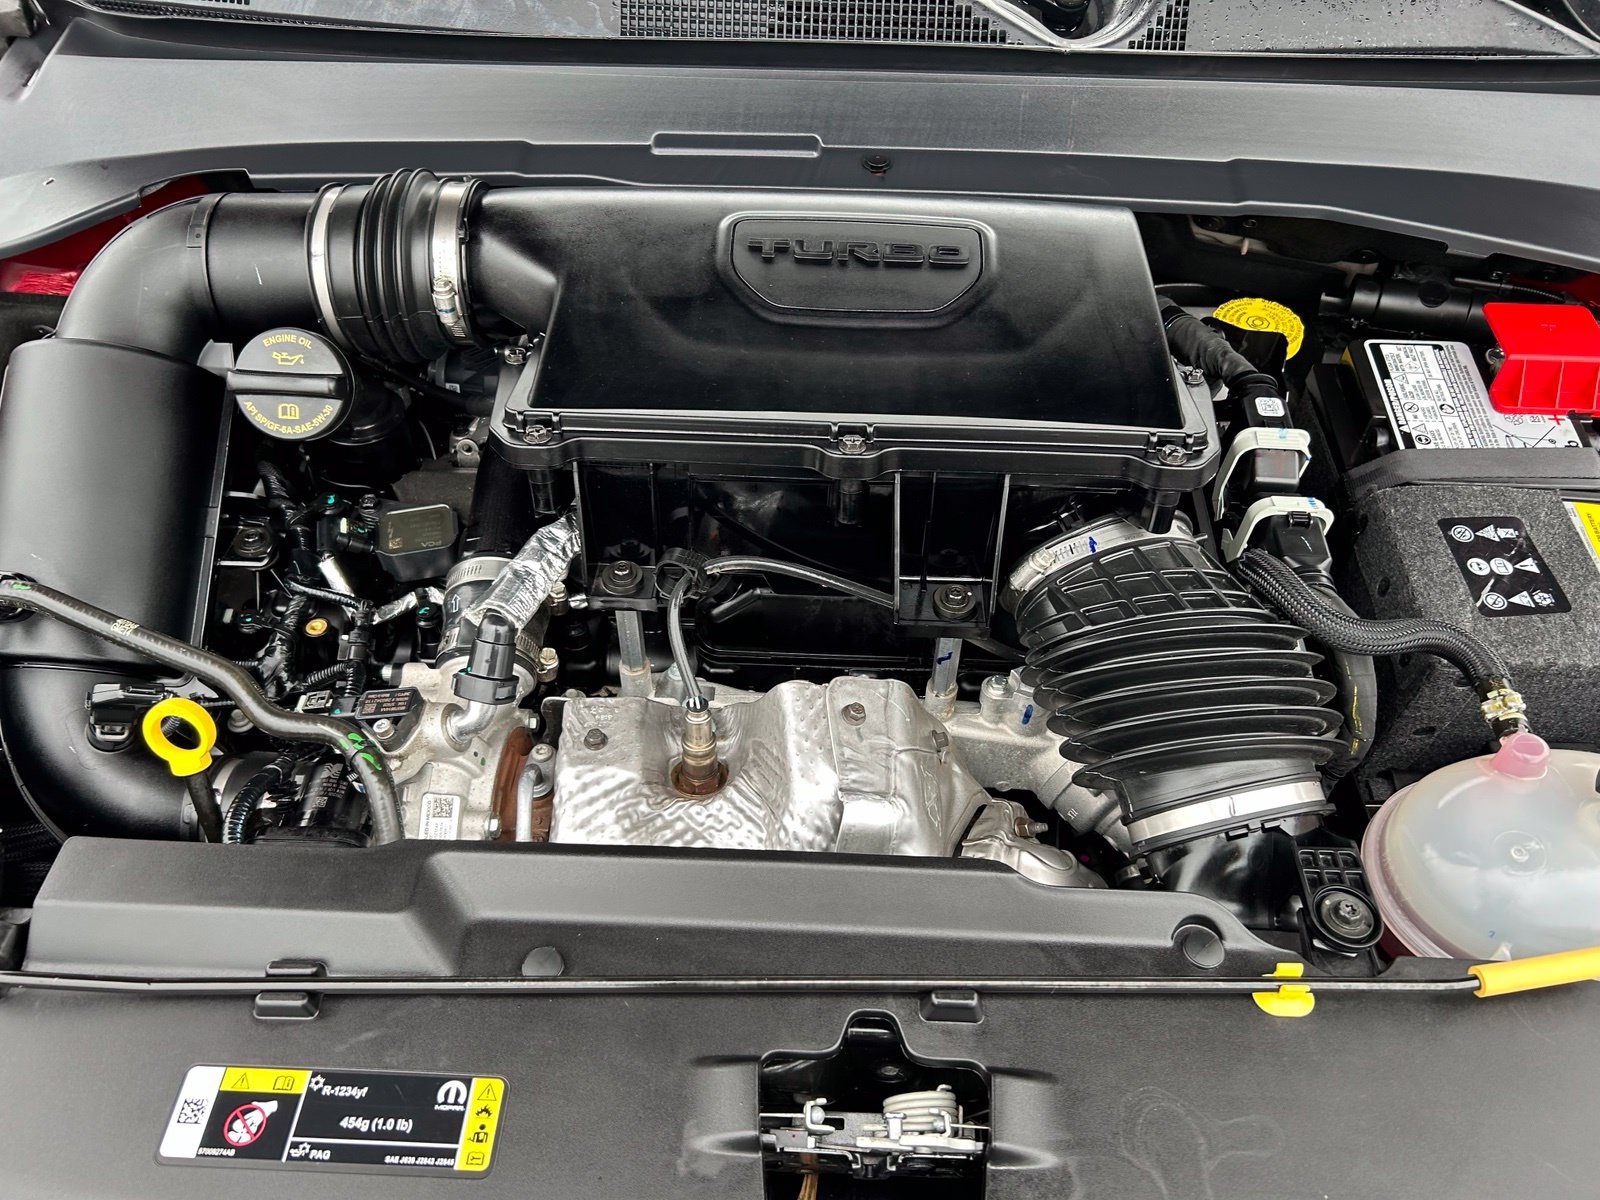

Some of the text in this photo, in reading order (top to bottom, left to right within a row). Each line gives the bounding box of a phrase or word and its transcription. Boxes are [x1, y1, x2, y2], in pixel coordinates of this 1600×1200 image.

[748, 237, 970, 266] TURBO
[263, 334, 313, 350] ENGINE OIL
[244, 400, 257, 416] API
[321, 1085, 369, 1100] R-1234yf
[339, 1116, 413, 1134] 454g (1.0 lb)
[309, 1149, 331, 1161] PAG
